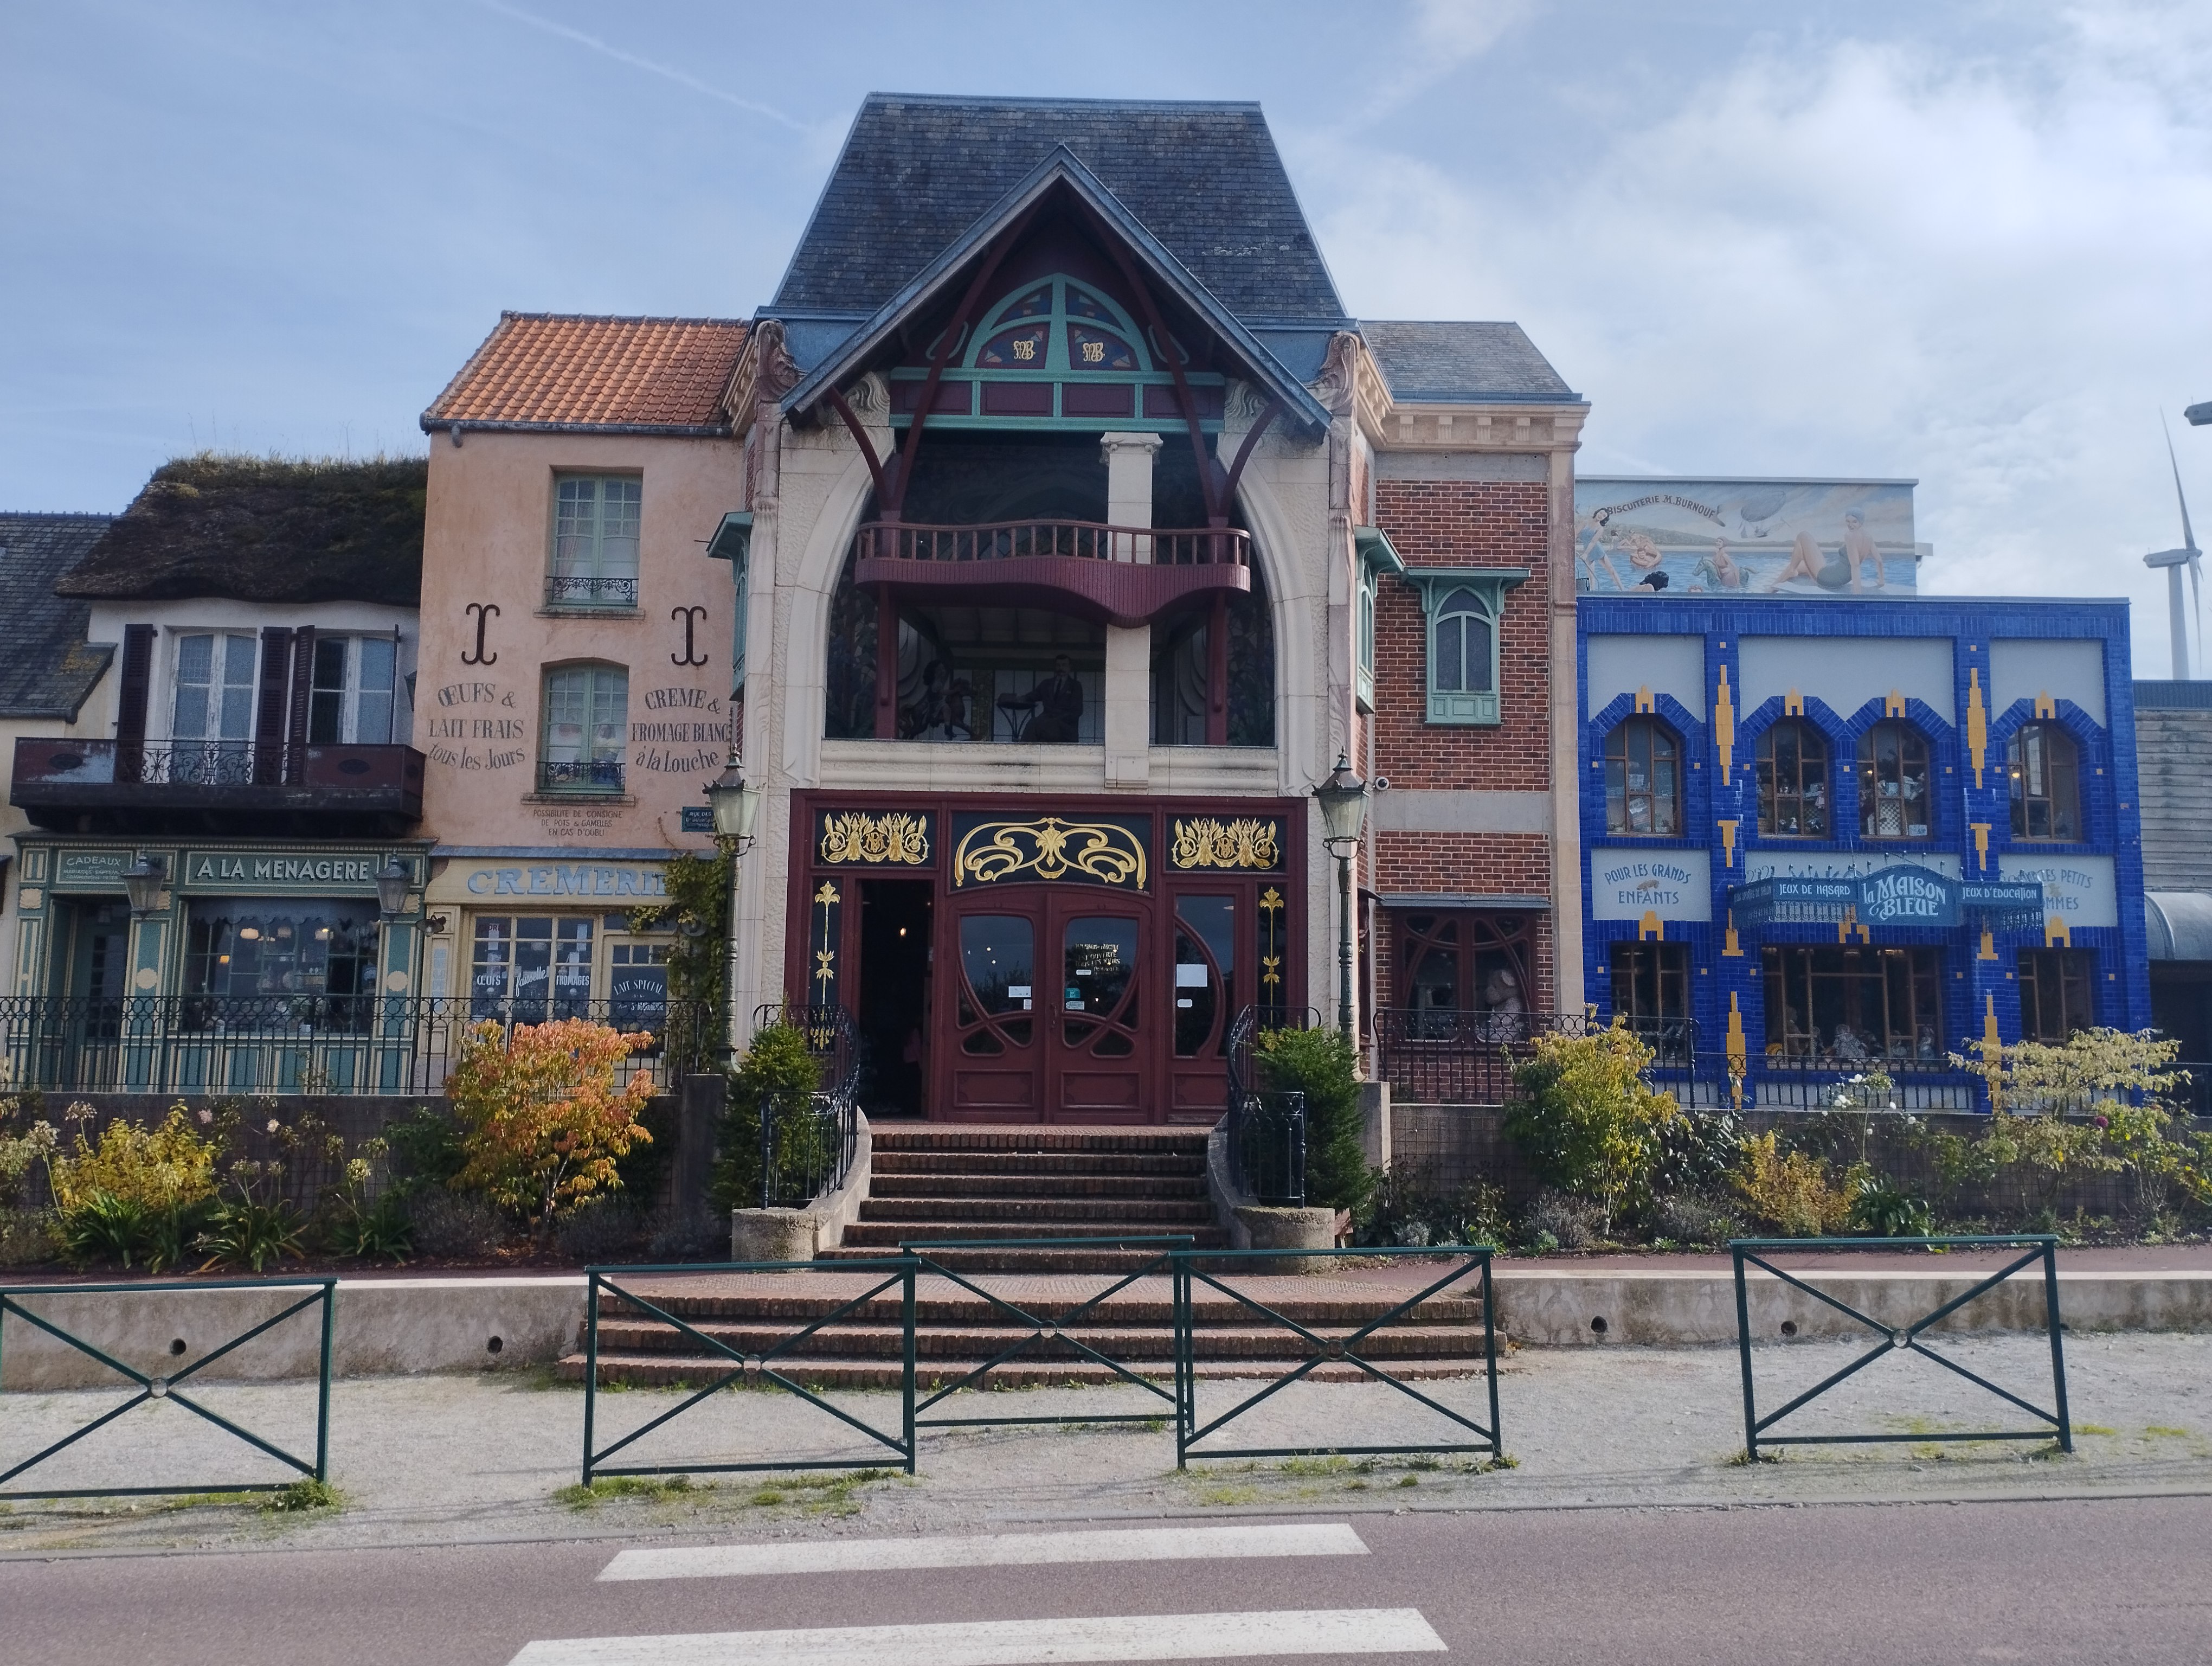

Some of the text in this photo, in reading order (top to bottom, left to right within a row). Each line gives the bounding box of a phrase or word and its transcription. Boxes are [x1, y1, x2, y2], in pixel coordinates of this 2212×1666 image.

[1607, 495, 1660, 515] BISCUITERIE
[438, 683, 516, 709] ŒUFS &
[645, 688, 720, 714] CREME &
[429, 719, 524, 739] LAIT FRAIS
[632, 723, 731, 742] FROMAGE BLANC
[427, 742, 525, 770] tous les Jours
[646, 748, 660, 771] la
[663, 749, 719, 772] Louche
[533, 809, 569, 817] POSSIBILITE
[67, 856, 121, 866] CADEAUX
[197, 856, 370, 880] A LA MENAGERE
[1604, 863, 1691, 885] POUR LES GRANDS
[2040, 869, 2056, 882] LES
[2061, 869, 2093, 888] PETITS
[1618, 890, 1679, 904] ENFANTS
[1779, 884, 1850, 898] JEUX DE HASARD
[1862, 874, 1946, 916] la MAISON
[1963, 886, 2037, 901] JEUX D'EDUCATION
[1880, 898, 1939, 920] BLEUE
[556, 975, 589, 986] FROMAGES
[614, 979, 663, 995] LAIT SPECIAL
